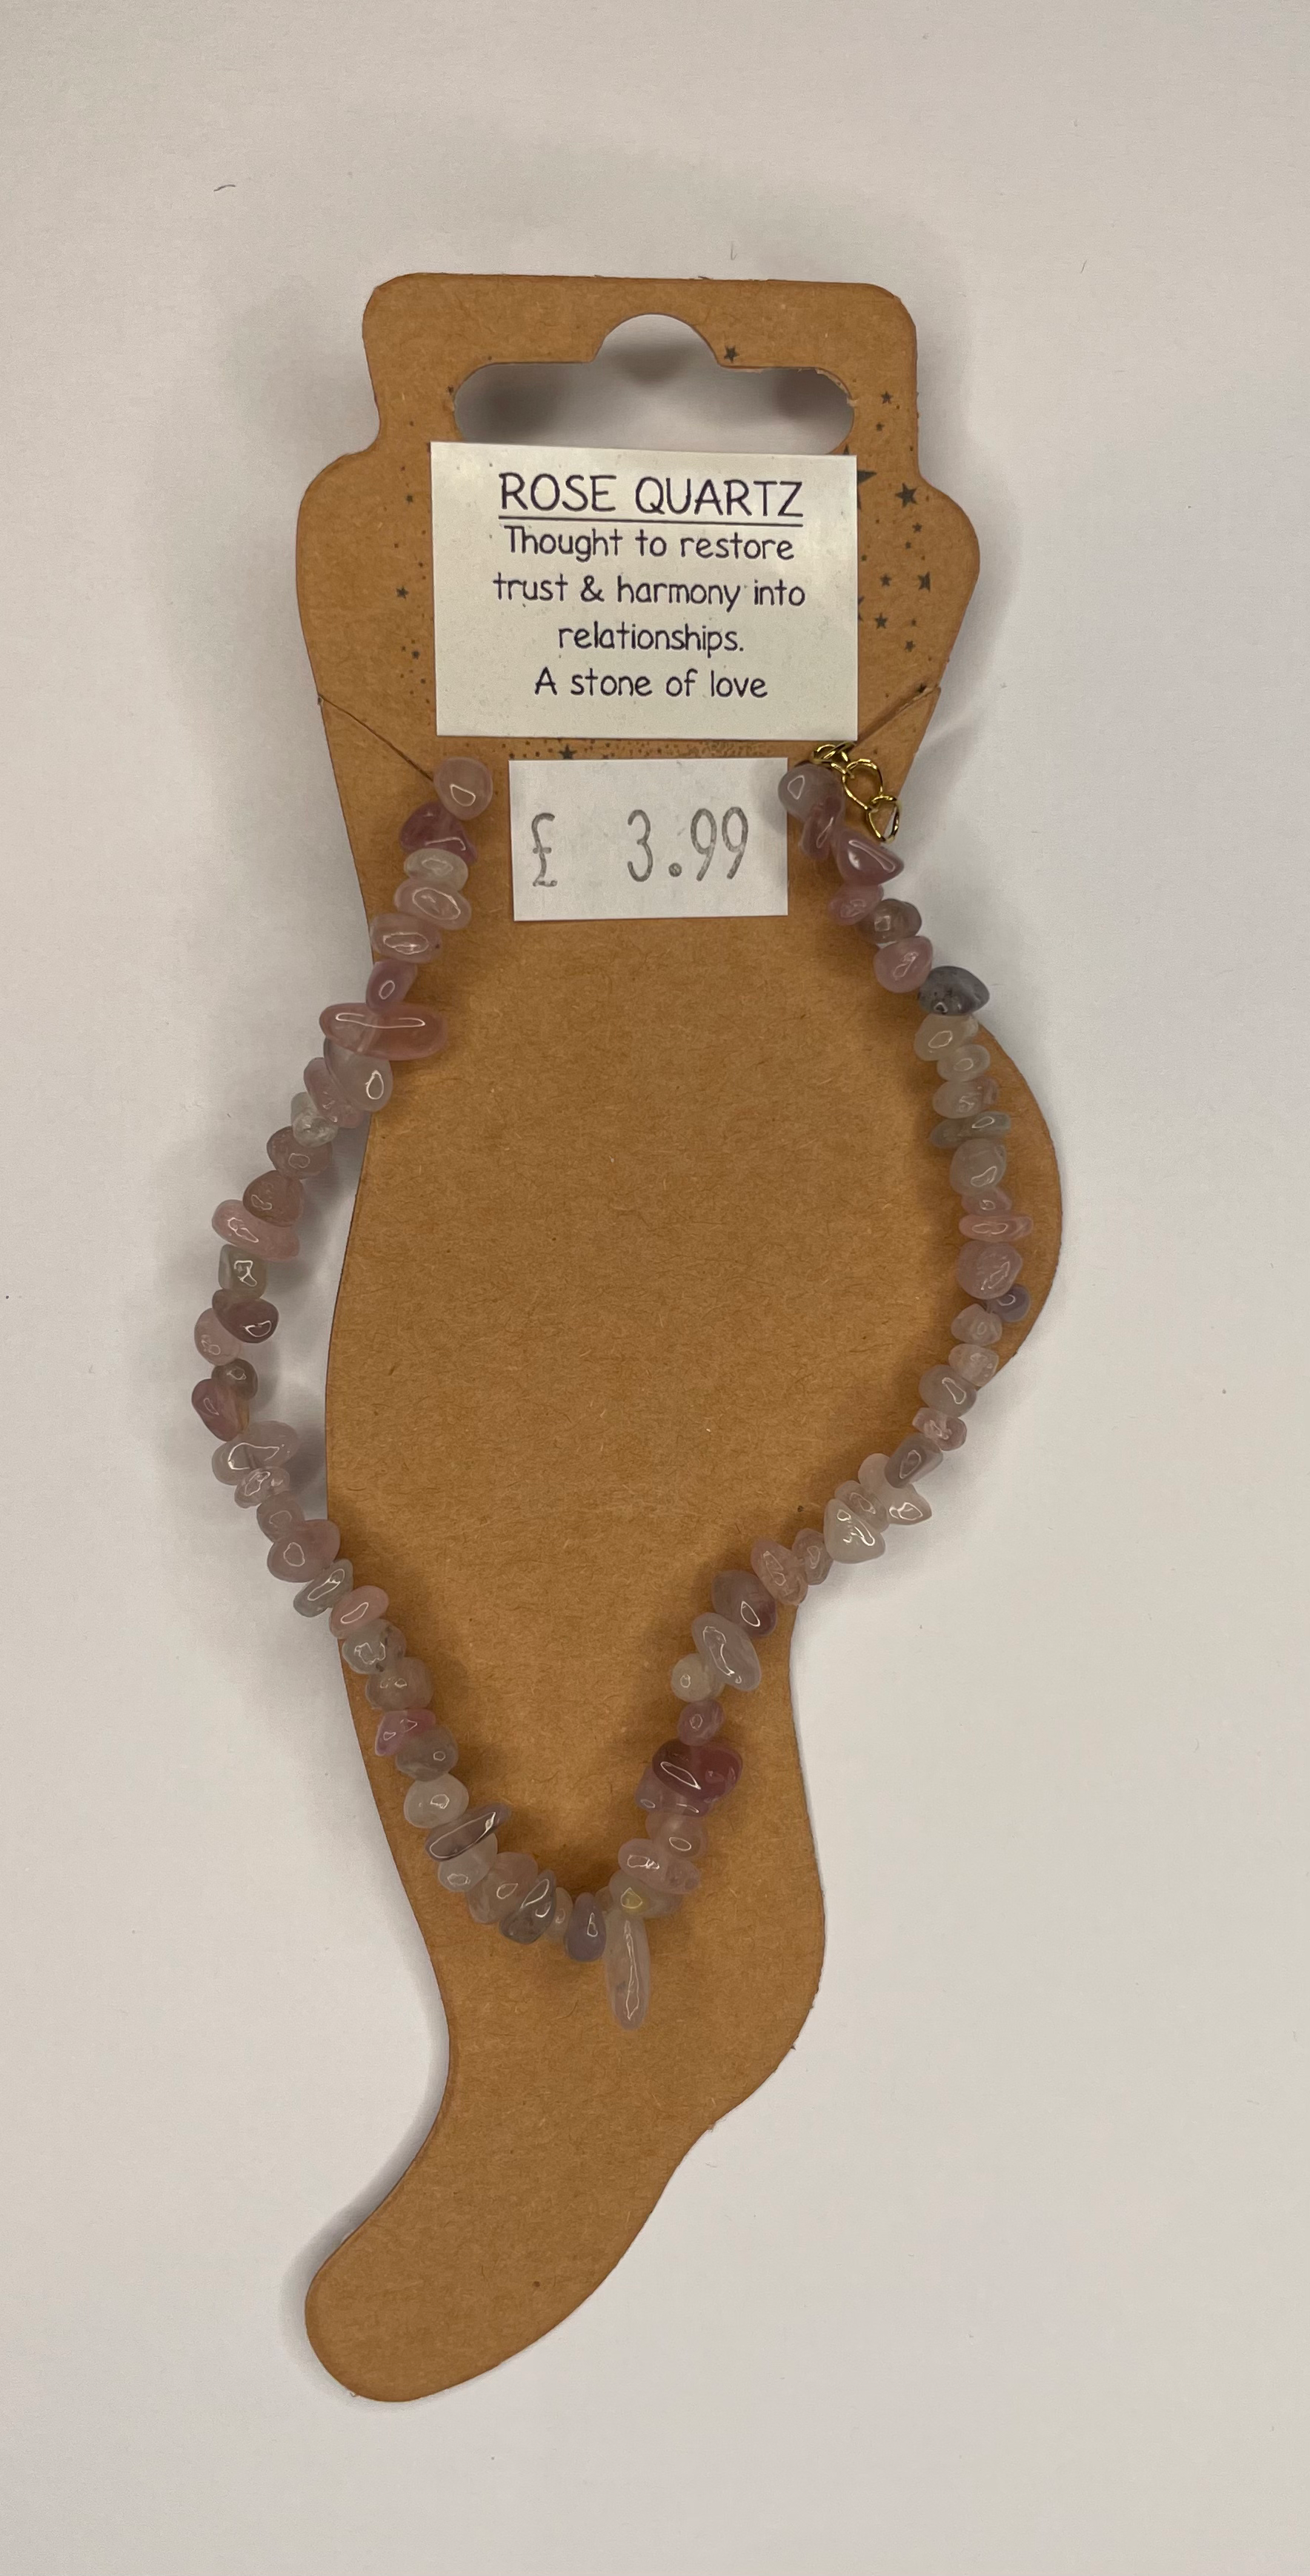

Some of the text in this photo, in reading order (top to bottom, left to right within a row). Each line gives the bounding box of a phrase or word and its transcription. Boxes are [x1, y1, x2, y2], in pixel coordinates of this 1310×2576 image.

[498, 472, 804, 517] ROSE QUARTZ
[503, 525, 795, 563] Thought to restore
[493, 572, 806, 613] trust & harmony into
[557, 620, 745, 659] relationships.
[533, 666, 768, 698] A stone of love
[531, 806, 749, 887] £ 3.99
